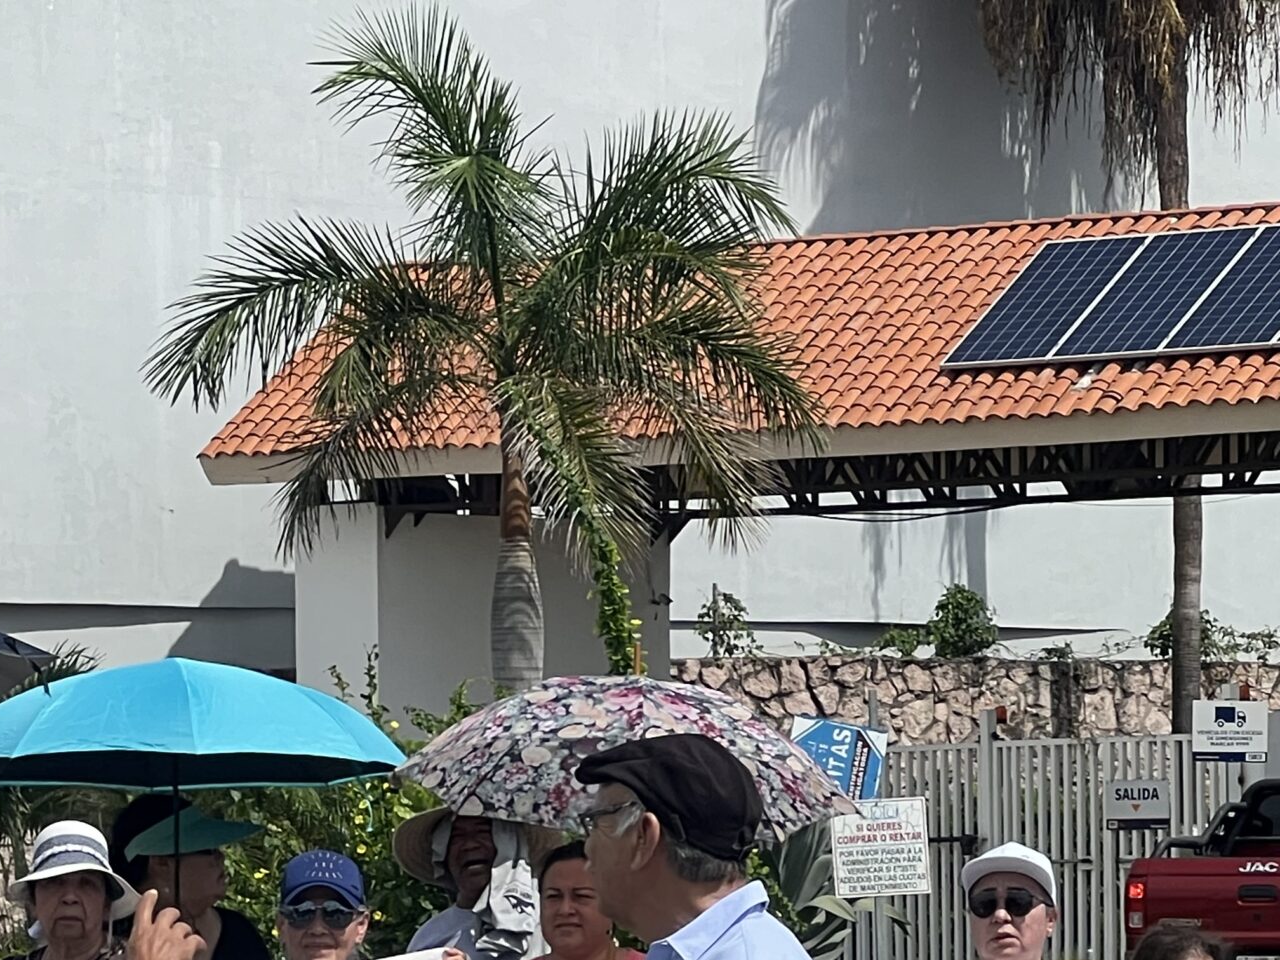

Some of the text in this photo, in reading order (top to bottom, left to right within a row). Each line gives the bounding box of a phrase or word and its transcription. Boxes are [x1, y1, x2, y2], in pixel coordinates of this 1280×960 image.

[1115, 787, 1160, 801] SALIDA
[856, 822, 903, 832] SI QUIERES
[837, 832, 922, 845] COMPRAR O RENTAR
[839, 850, 854, 858] POR
[856, 849, 879, 857] FAVOR
[881, 848, 905, 856] PASAR
[914, 846, 923, 854] LA
[846, 866, 884, 875] VERIFICAR
[1238, 861, 1279, 873] JAC
[840, 875, 872, 884] ADEUDOS
[873, 874, 882, 882] EN
[848, 885, 857, 893] DE
